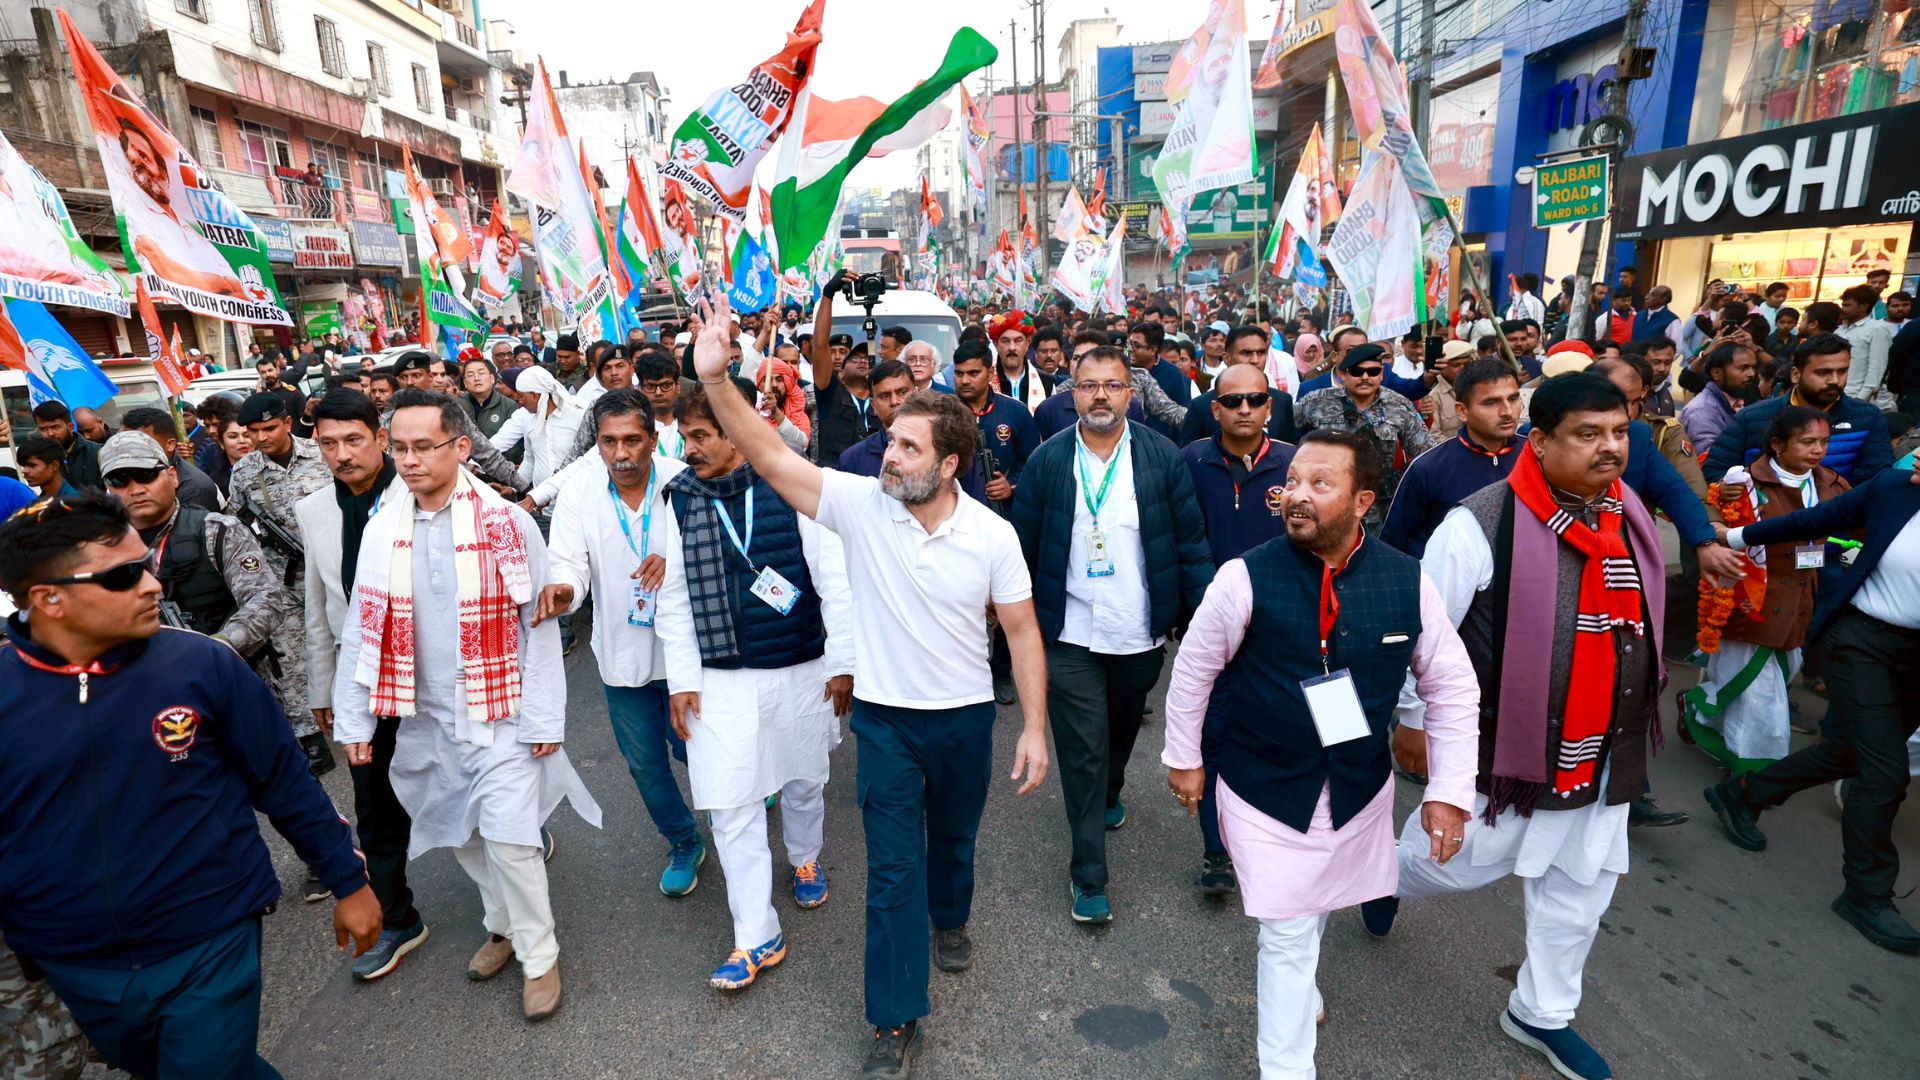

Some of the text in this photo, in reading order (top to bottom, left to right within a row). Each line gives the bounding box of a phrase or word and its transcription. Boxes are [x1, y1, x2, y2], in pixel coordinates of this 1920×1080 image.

[1292, 19, 1323, 45] PLAZA
[1541, 165, 1601, 186] RAJBARI
[1636, 124, 1881, 228] MOCHI
[1551, 186, 1590, 204] ROAD
[1544, 207, 1572, 220] WARD
[197, 219, 249, 248] YATRA
[306, 236, 338, 251] FRIENDS
[295, 251, 326, 267] MEDICAL
[13, 281, 65, 304] YOUTH
[68, 291, 129, 316] CONGRESS
[181, 290, 219, 313] YOUTH
[219, 300, 285, 322] CONGRESS
[733, 288, 759, 309] NSUI
[170, 750, 189, 762] 235
